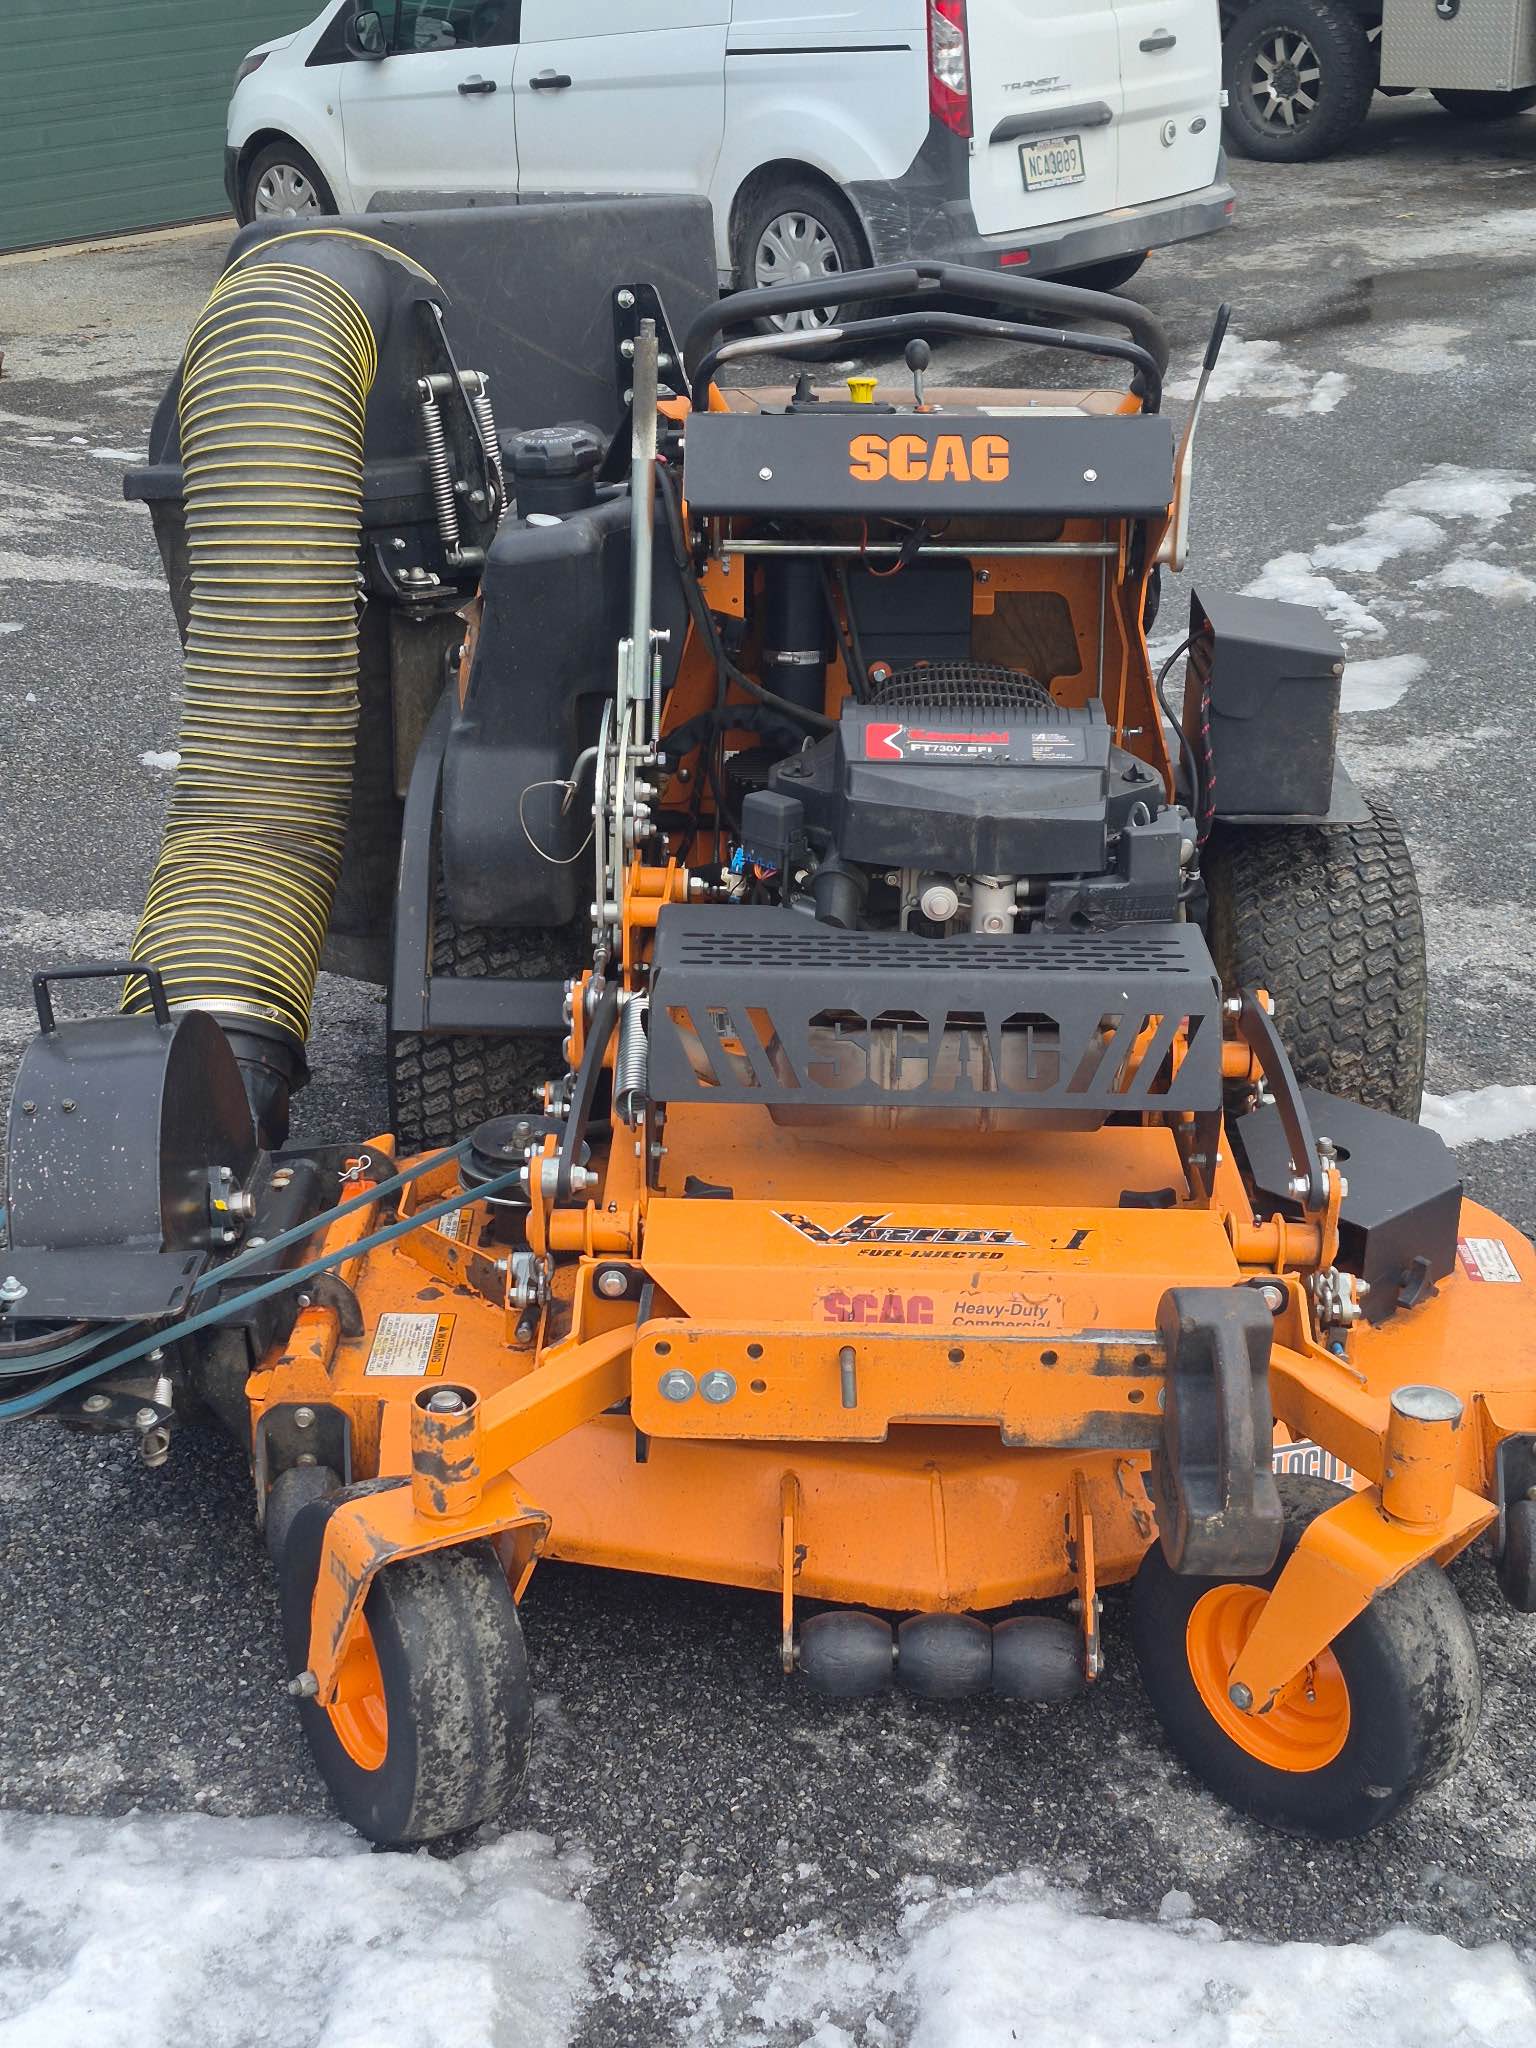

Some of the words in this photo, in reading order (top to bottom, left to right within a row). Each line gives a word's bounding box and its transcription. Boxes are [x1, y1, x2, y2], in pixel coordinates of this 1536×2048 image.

[1001, 75, 1060, 92] TRANSIT
[849, 434, 1009, 482] SCAG
[911, 744, 962, 753] FT730V
[807, 1009, 1060, 1092] SCAG
[858, 1249, 1004, 1260] FUEL-INJECTED
[822, 1292, 934, 1325] SCAG
[953, 1302, 1049, 1320] Heavy-Duty
